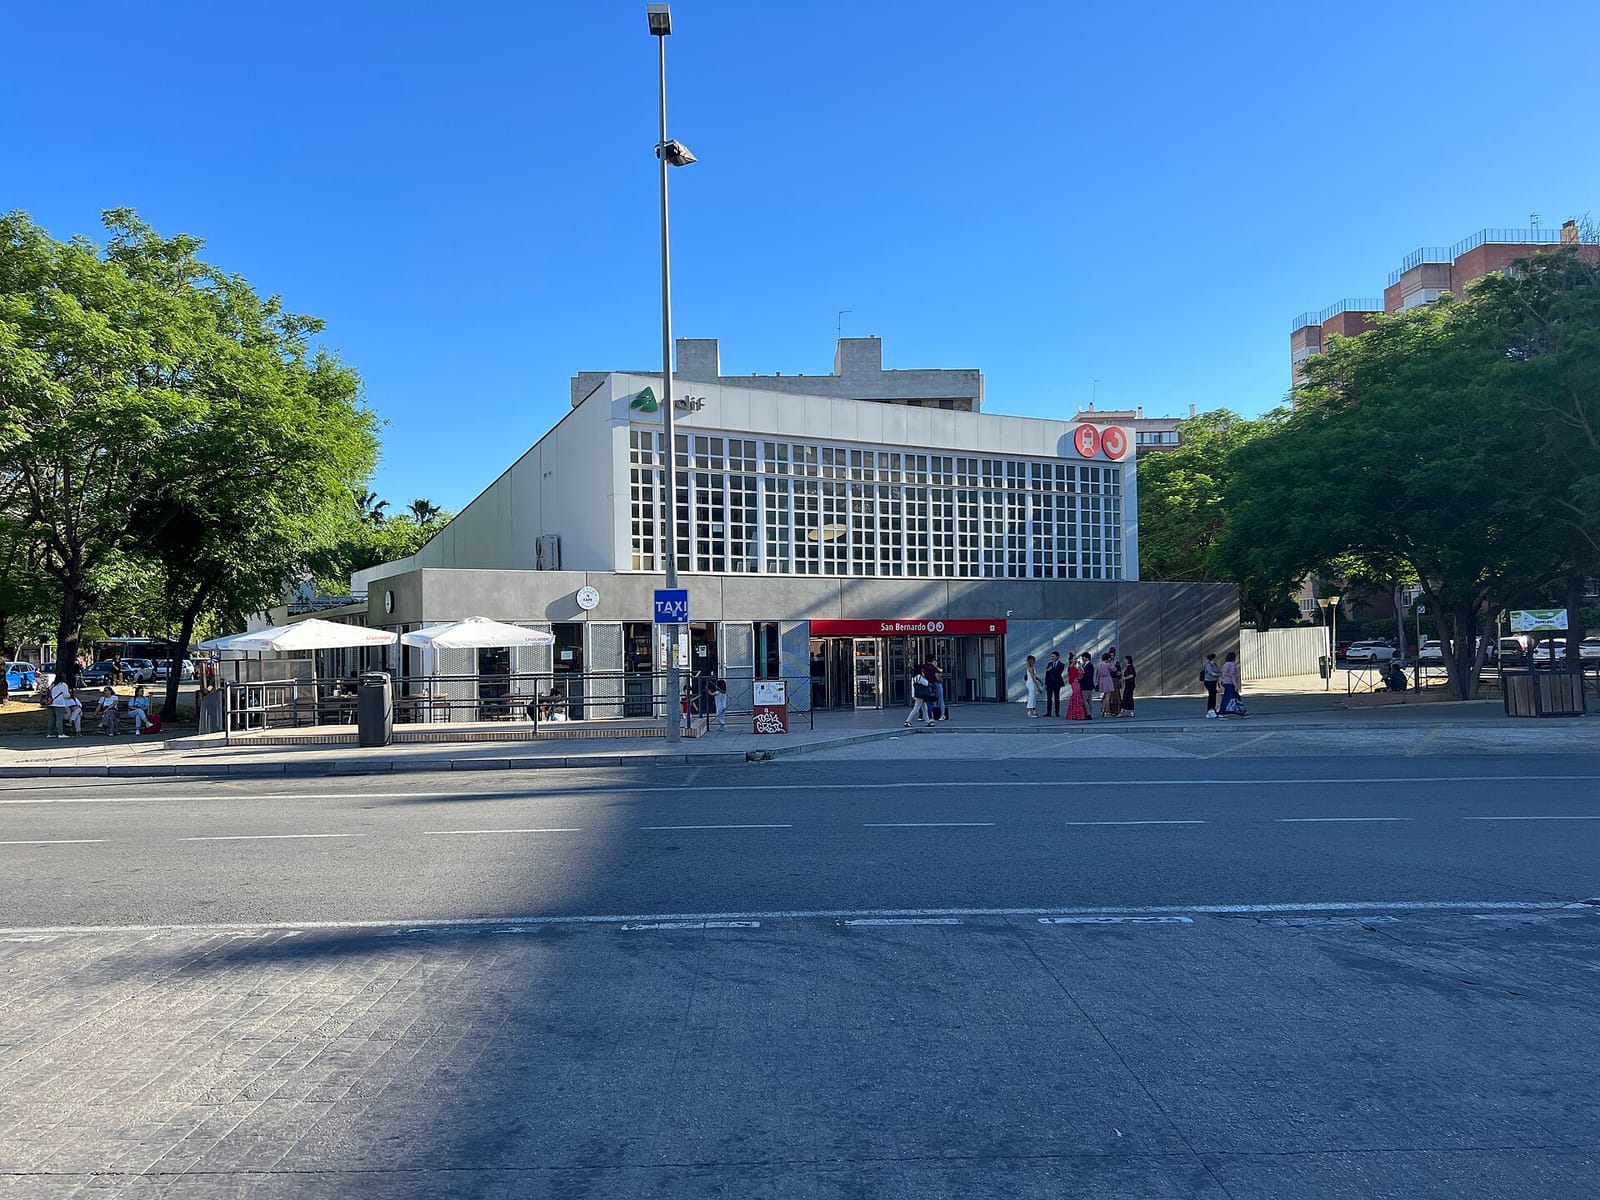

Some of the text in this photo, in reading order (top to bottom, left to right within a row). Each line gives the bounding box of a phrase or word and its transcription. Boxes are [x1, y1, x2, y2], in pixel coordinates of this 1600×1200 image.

[659, 395, 706, 411] dif
[655, 601, 687, 612] TAXI
[880, 622, 926, 631] San Bernardo
